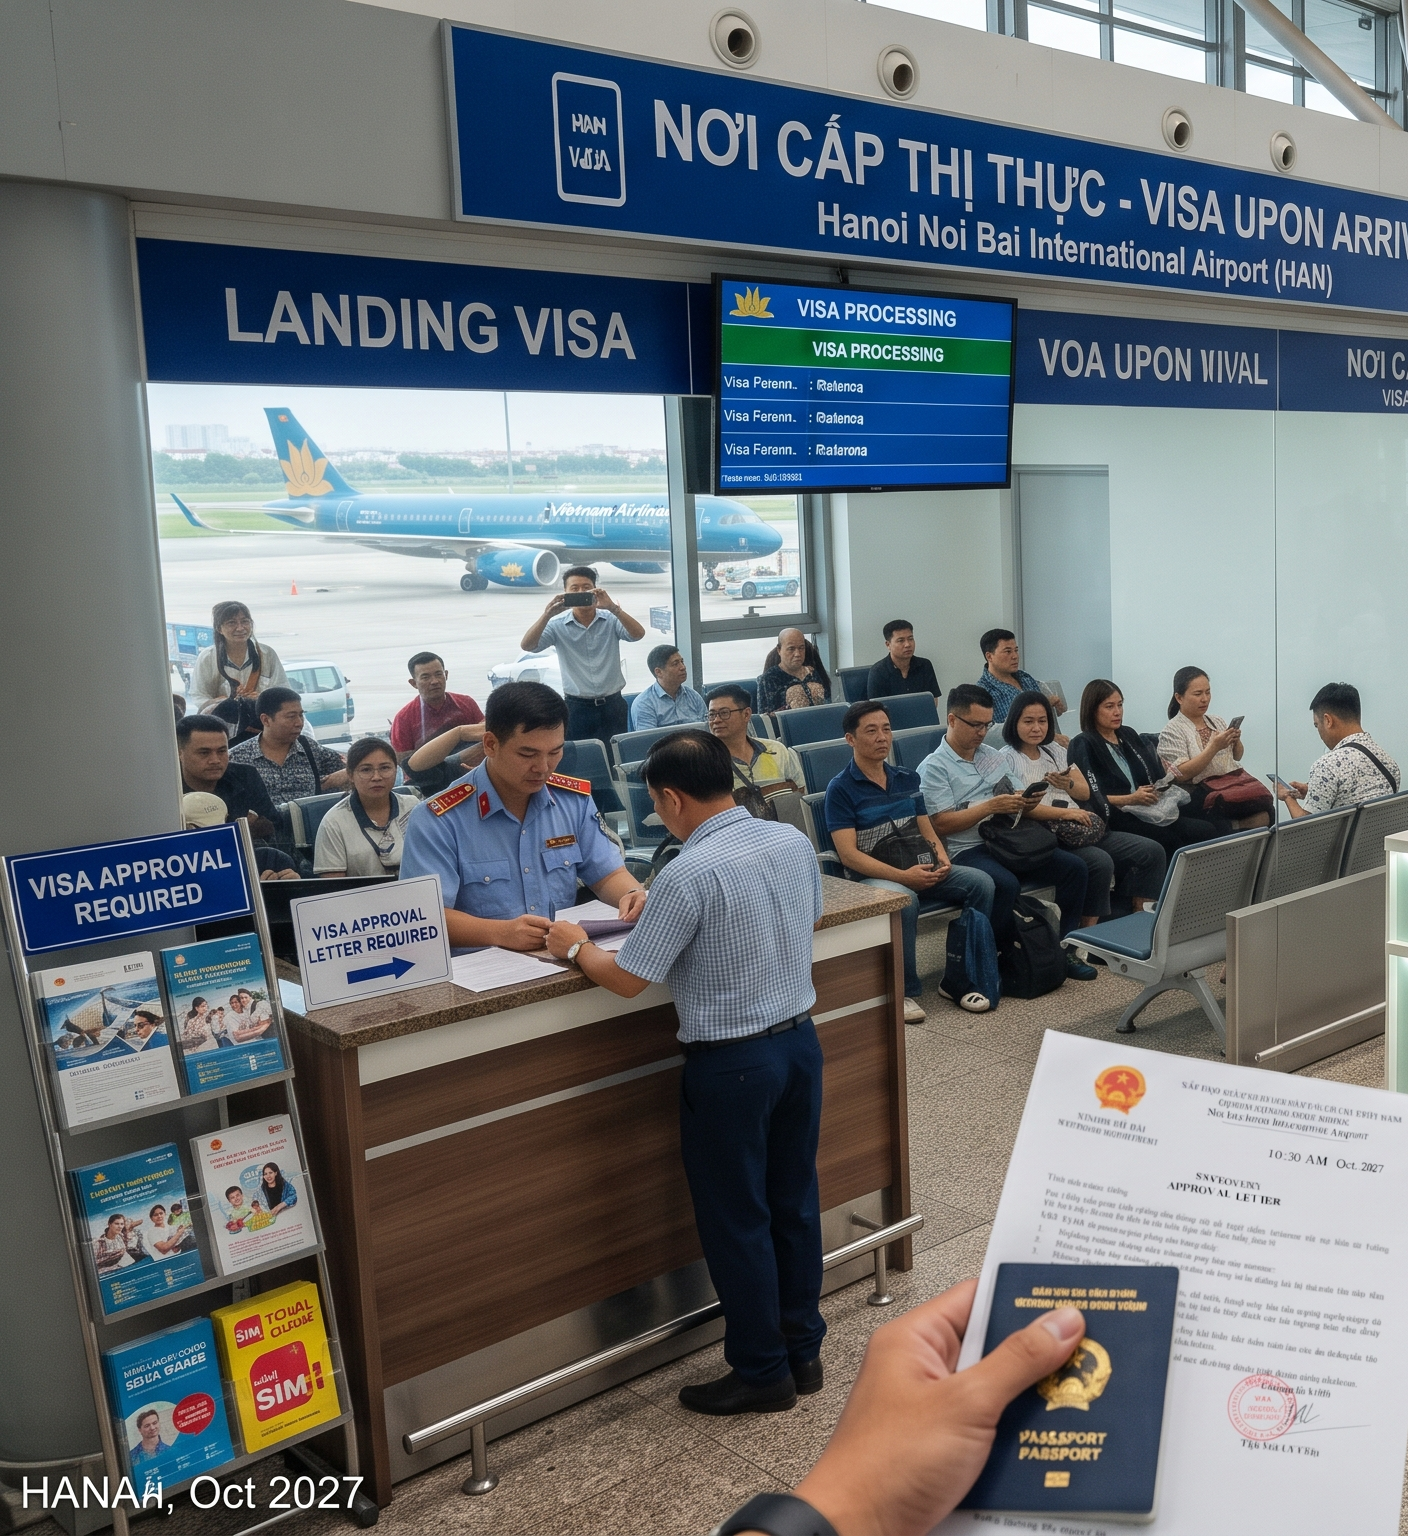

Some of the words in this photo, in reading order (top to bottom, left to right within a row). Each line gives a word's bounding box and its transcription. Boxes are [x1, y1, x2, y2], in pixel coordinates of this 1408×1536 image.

[653, 99, 759, 171] NƠI
[777, 113, 885, 186] CẤP
[899, 138, 975, 213] THỊ
[987, 152, 1107, 226] THỰC
[1140, 178, 1226, 235] VISA
[1234, 196, 1324, 249] UPON
[817, 201, 908, 245] Hanoi
[918, 213, 967, 252] Noi
[976, 225, 1020, 257] Bai
[1030, 227, 1186, 275] International
[1192, 248, 1269, 288] Airport
[1274, 259, 1333, 298] (HAN)
[225, 287, 498, 354] LANDING
[514, 305, 637, 360] VISA
[797, 299, 840, 320] VISA
[845, 302, 957, 328] PROCESSING
[812, 341, 847, 358] VISA
[851, 343, 944, 363] PROCESSING
[1038, 338, 1106, 378] VOA
[1114, 343, 1192, 382] UPON
[1347, 348, 1386, 379] NƠI
[724, 376, 749, 388] Visa
[724, 410, 749, 422] Visa
[724, 443, 750, 456] Visa
[550, 502, 614, 517] Vietnam
[28, 870, 94, 901] VISA
[98, 848, 232, 891] APPROVAL
[74, 883, 203, 925] REQUIRED
[311, 923, 349, 942] VISA
[352, 907, 427, 934] APPROVAL
[307, 940, 364, 965] LETTER
[367, 925, 439, 951] REQUIRED
[1269, 1149, 1302, 1162] 10:30
[1305, 1155, 1328, 1167] AM
[1166, 1181, 1231, 1199] APPROVAL
